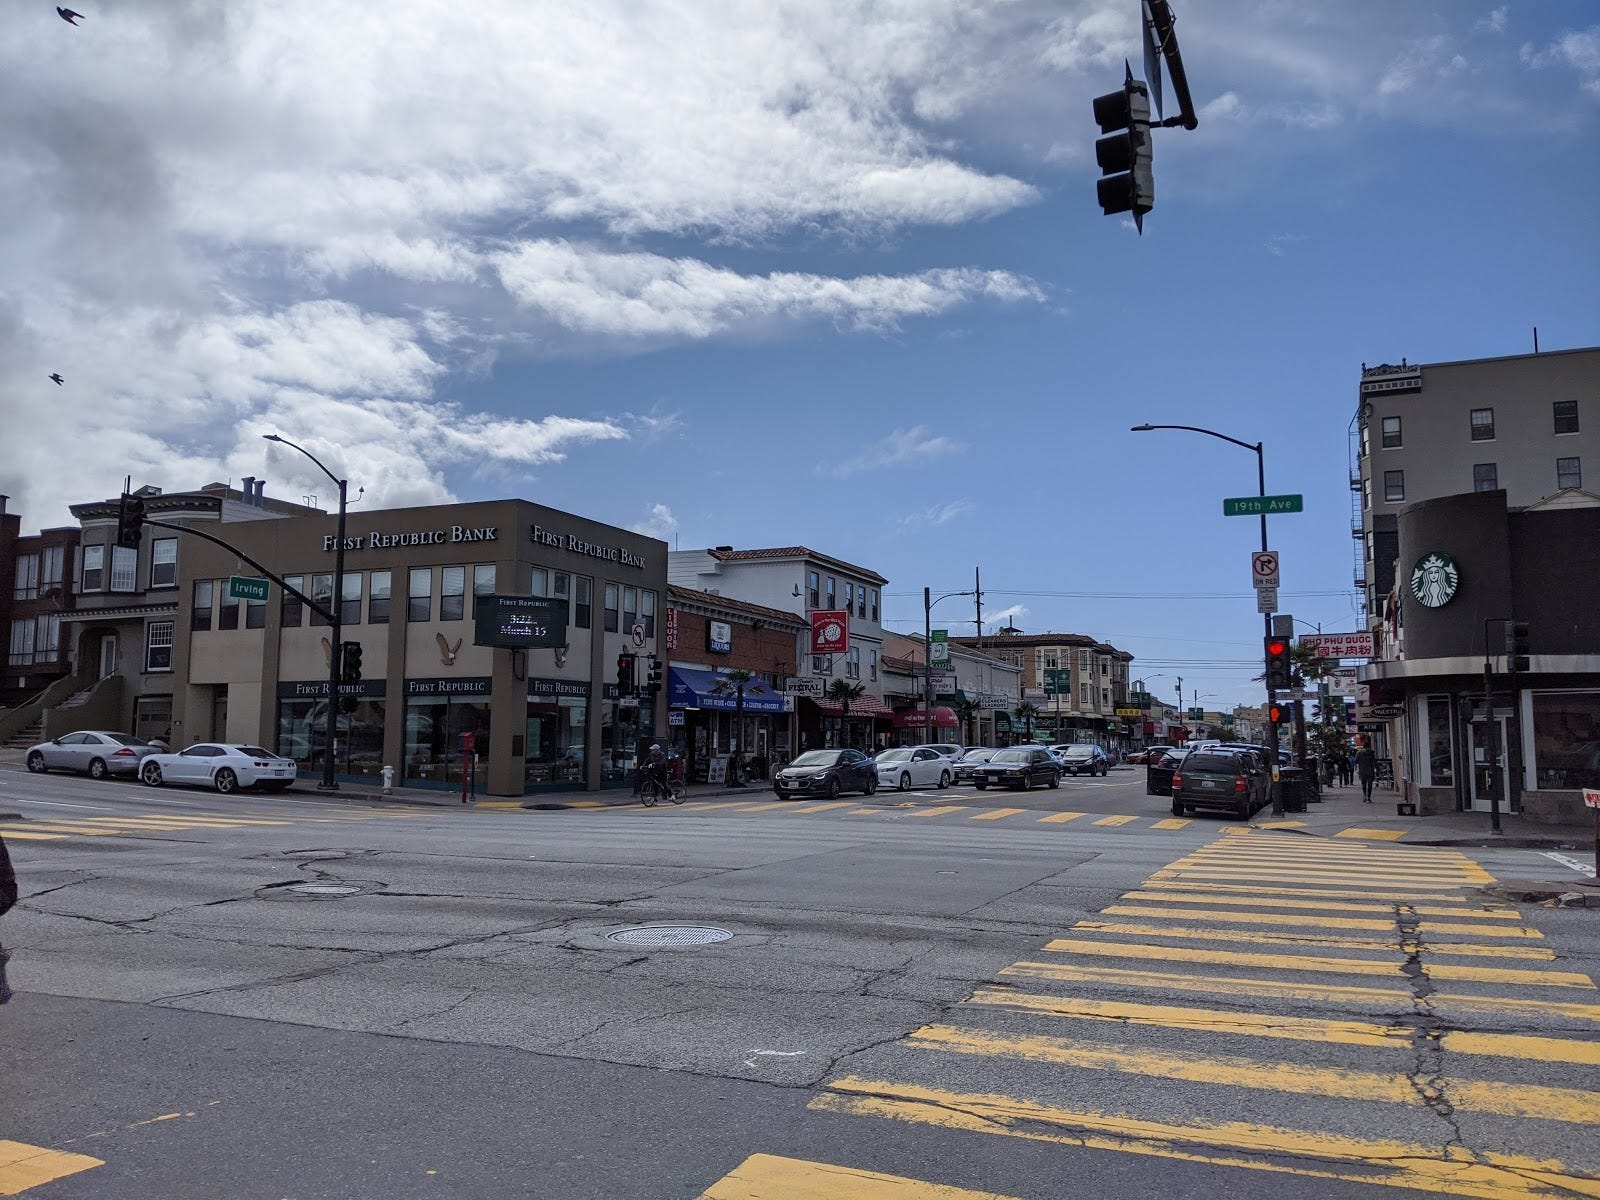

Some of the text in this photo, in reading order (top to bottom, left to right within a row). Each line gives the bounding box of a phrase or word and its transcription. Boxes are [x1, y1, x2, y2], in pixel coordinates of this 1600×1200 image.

[1234, 500, 1292, 512] 19th Ave
[369, 531, 445, 548] REPUBLIC
[451, 525, 496, 542] BANK
[534, 525, 646, 568] FIRST REPUBLIC BANK
[235, 583, 264, 597] Irving
[296, 683, 320, 694] FIRST
[409, 680, 485, 692] FIRST REPUBLIC
[534, 681, 587, 694] FIRST REPUBLIC
